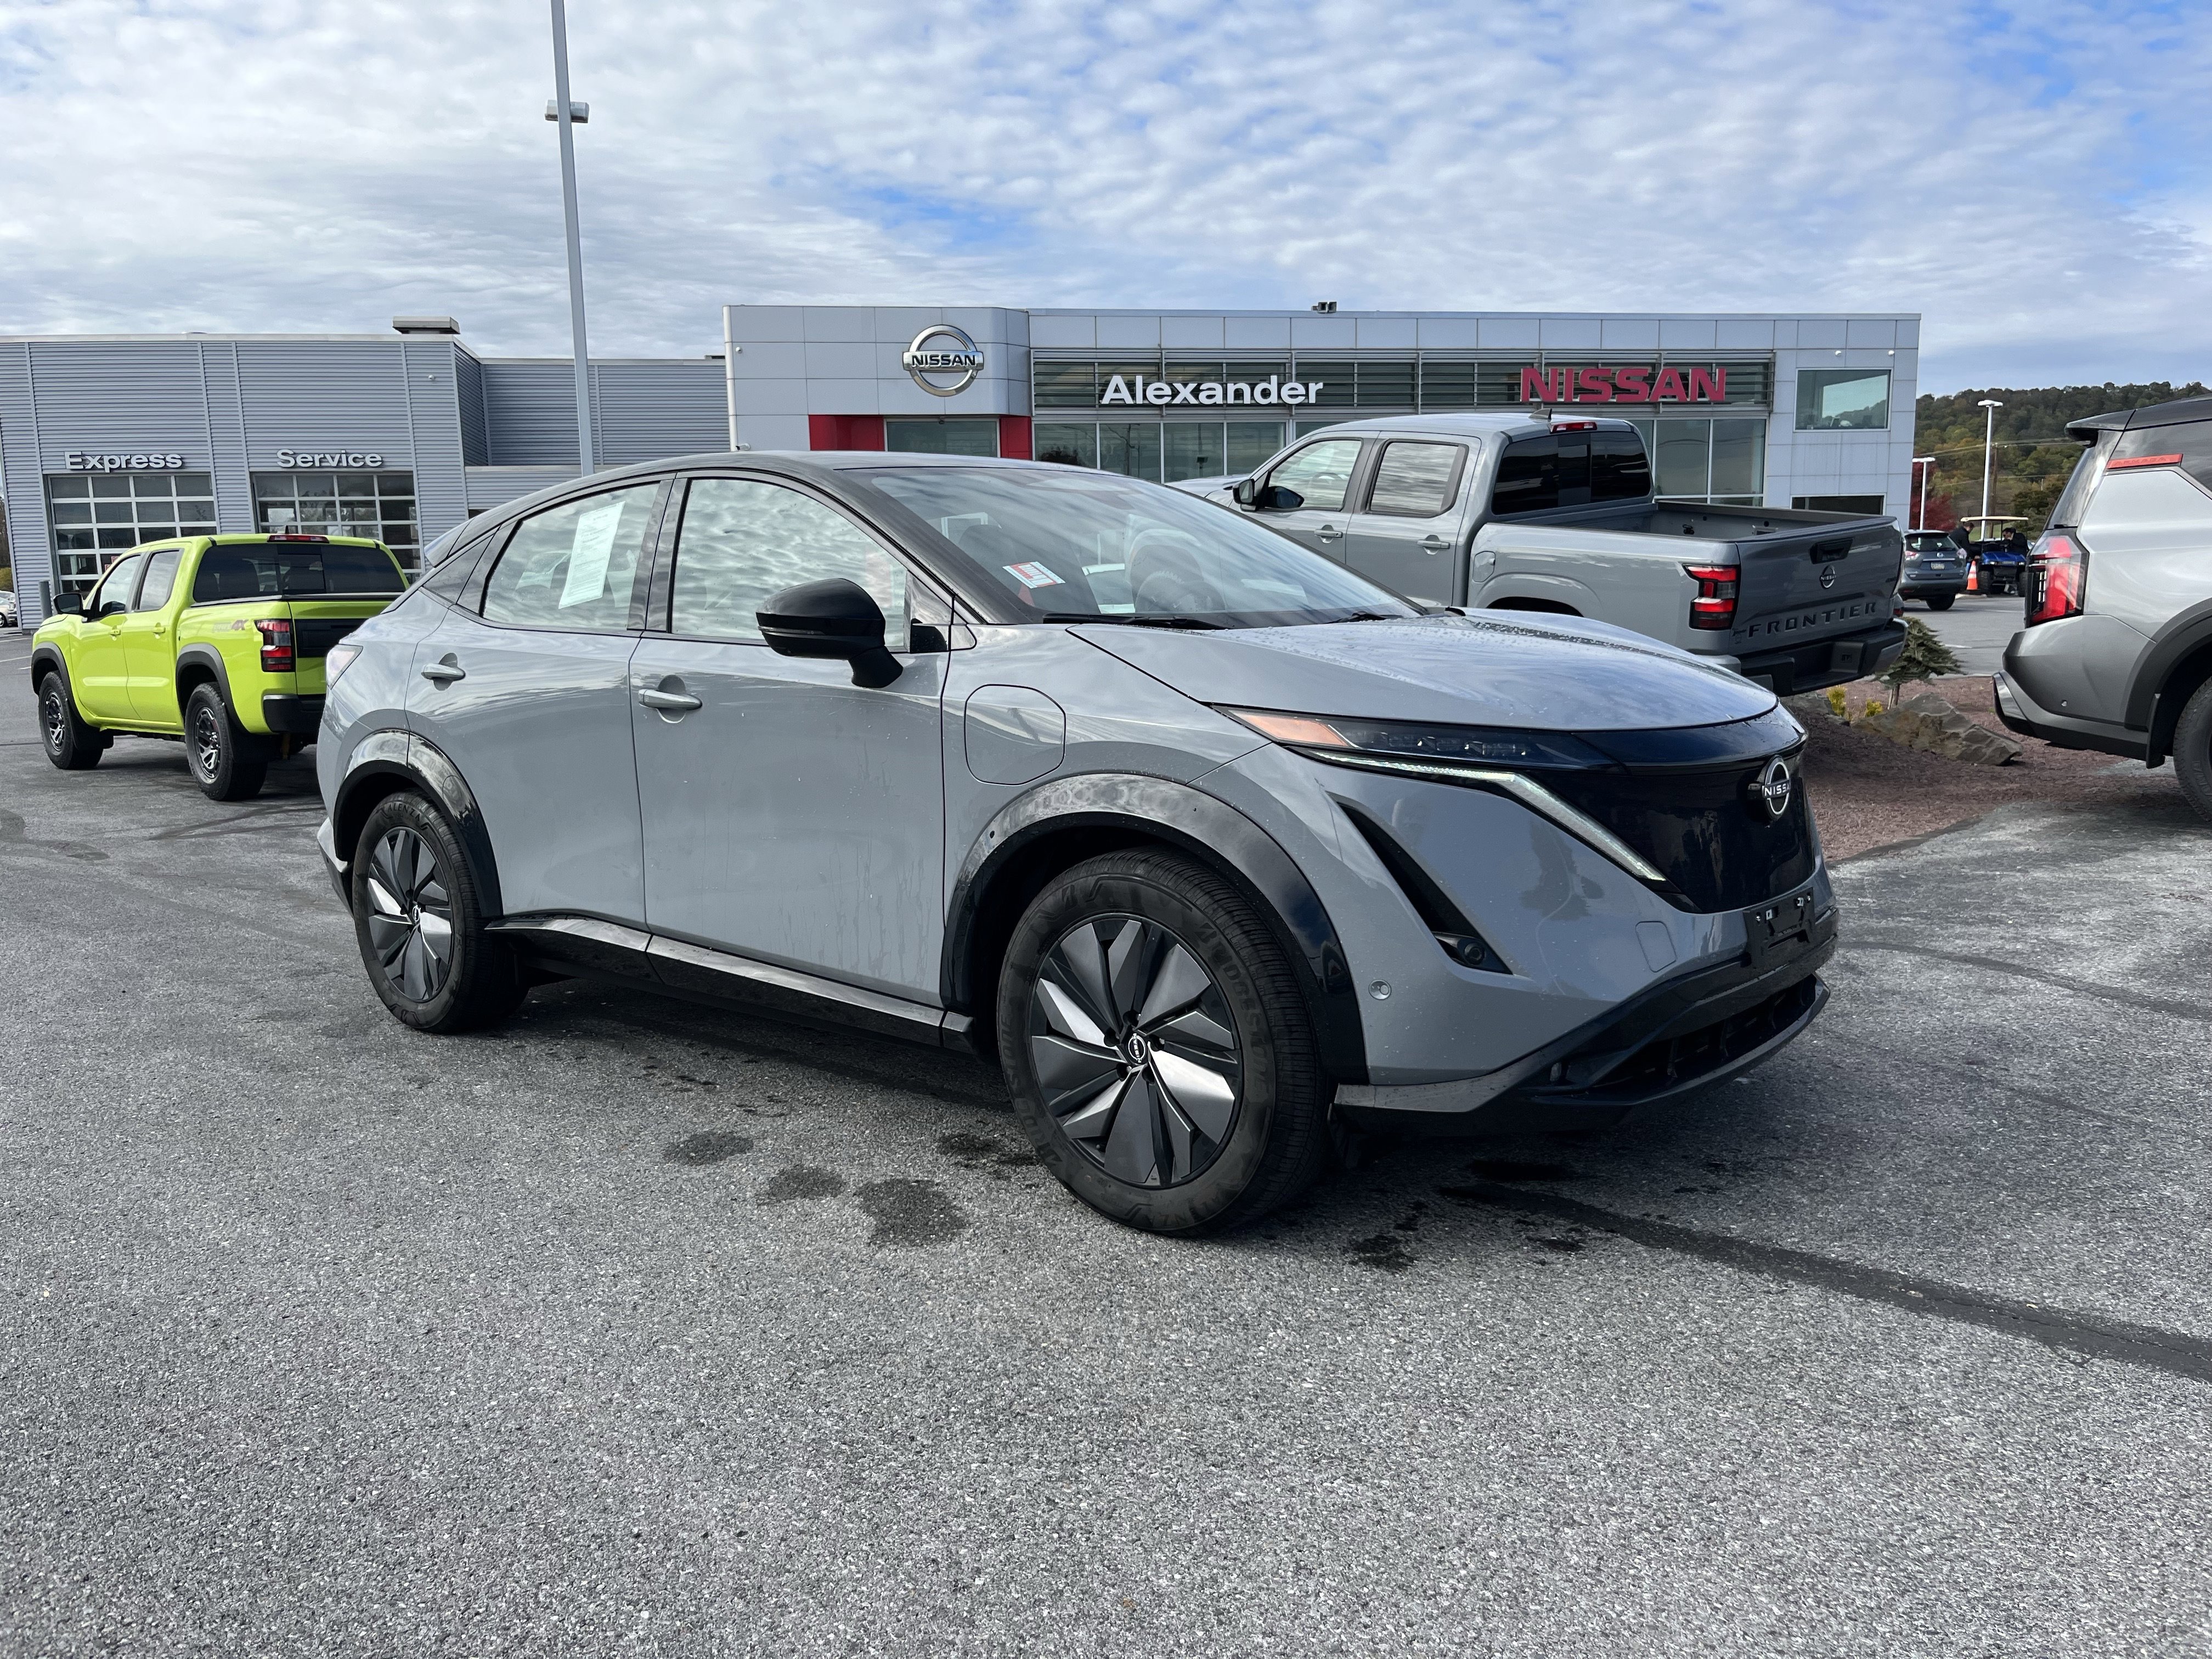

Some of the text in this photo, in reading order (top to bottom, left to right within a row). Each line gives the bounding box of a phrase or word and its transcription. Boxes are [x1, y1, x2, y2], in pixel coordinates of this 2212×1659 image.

[911, 354, 976, 367] NISSAN
[1101, 375, 1323, 405] Alexander
[1521, 368, 1726, 402] NISSAN
[64, 450, 183, 473] Express
[276, 449, 383, 467] Service
[1748, 601, 1876, 638] FRONTIER
[1764, 781, 1790, 797] NISS
[387, 803, 421, 822] ALENZA
